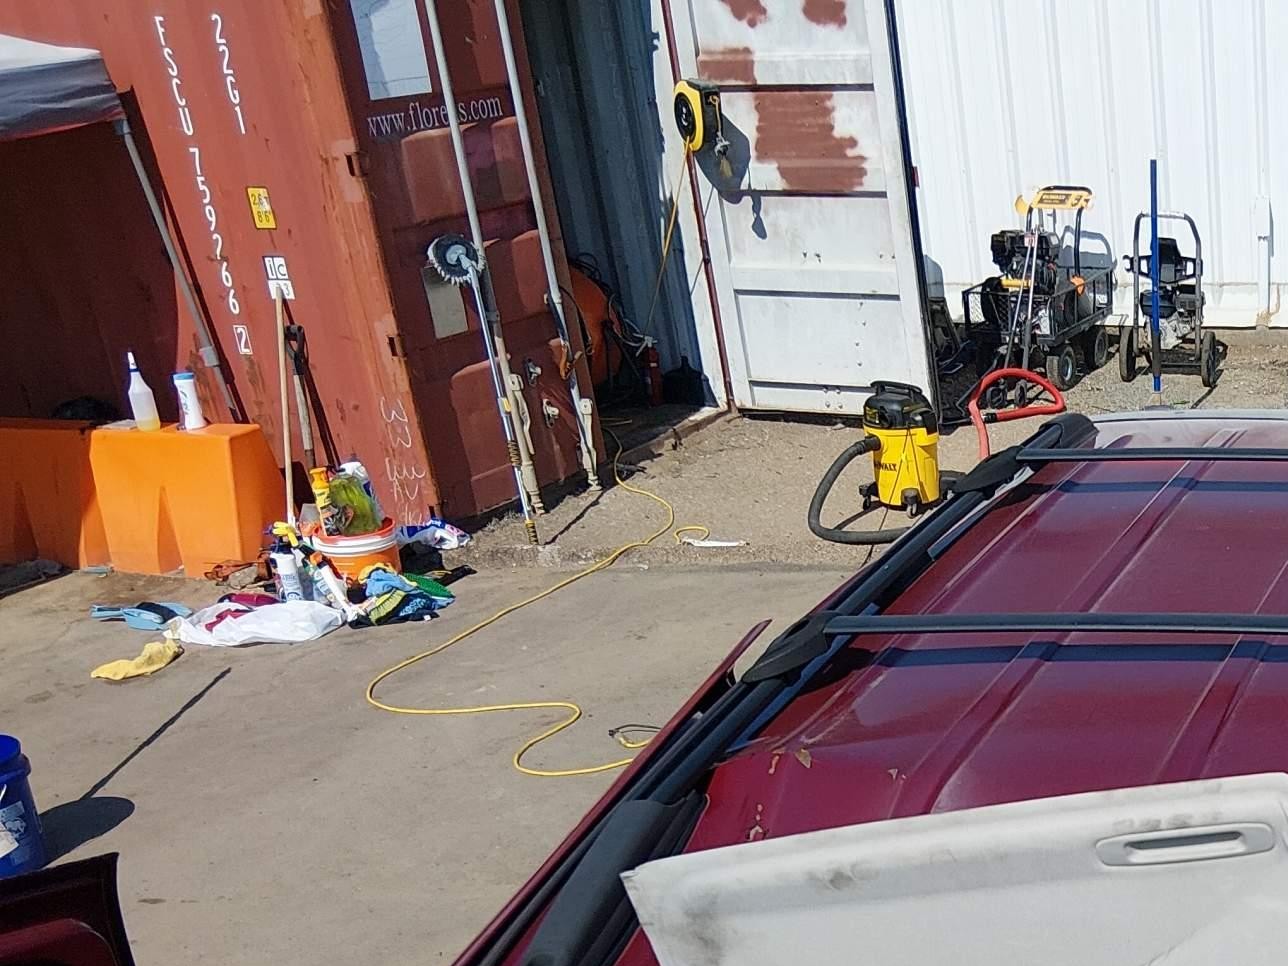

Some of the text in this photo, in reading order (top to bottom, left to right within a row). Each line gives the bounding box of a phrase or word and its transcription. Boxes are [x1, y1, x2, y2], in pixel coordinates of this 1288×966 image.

[211, 13, 246, 135] 22G1
[367, 97, 503, 137] www.flores.com
[154, 15, 194, 136] FSCU
[235, 326, 251, 354] 2
